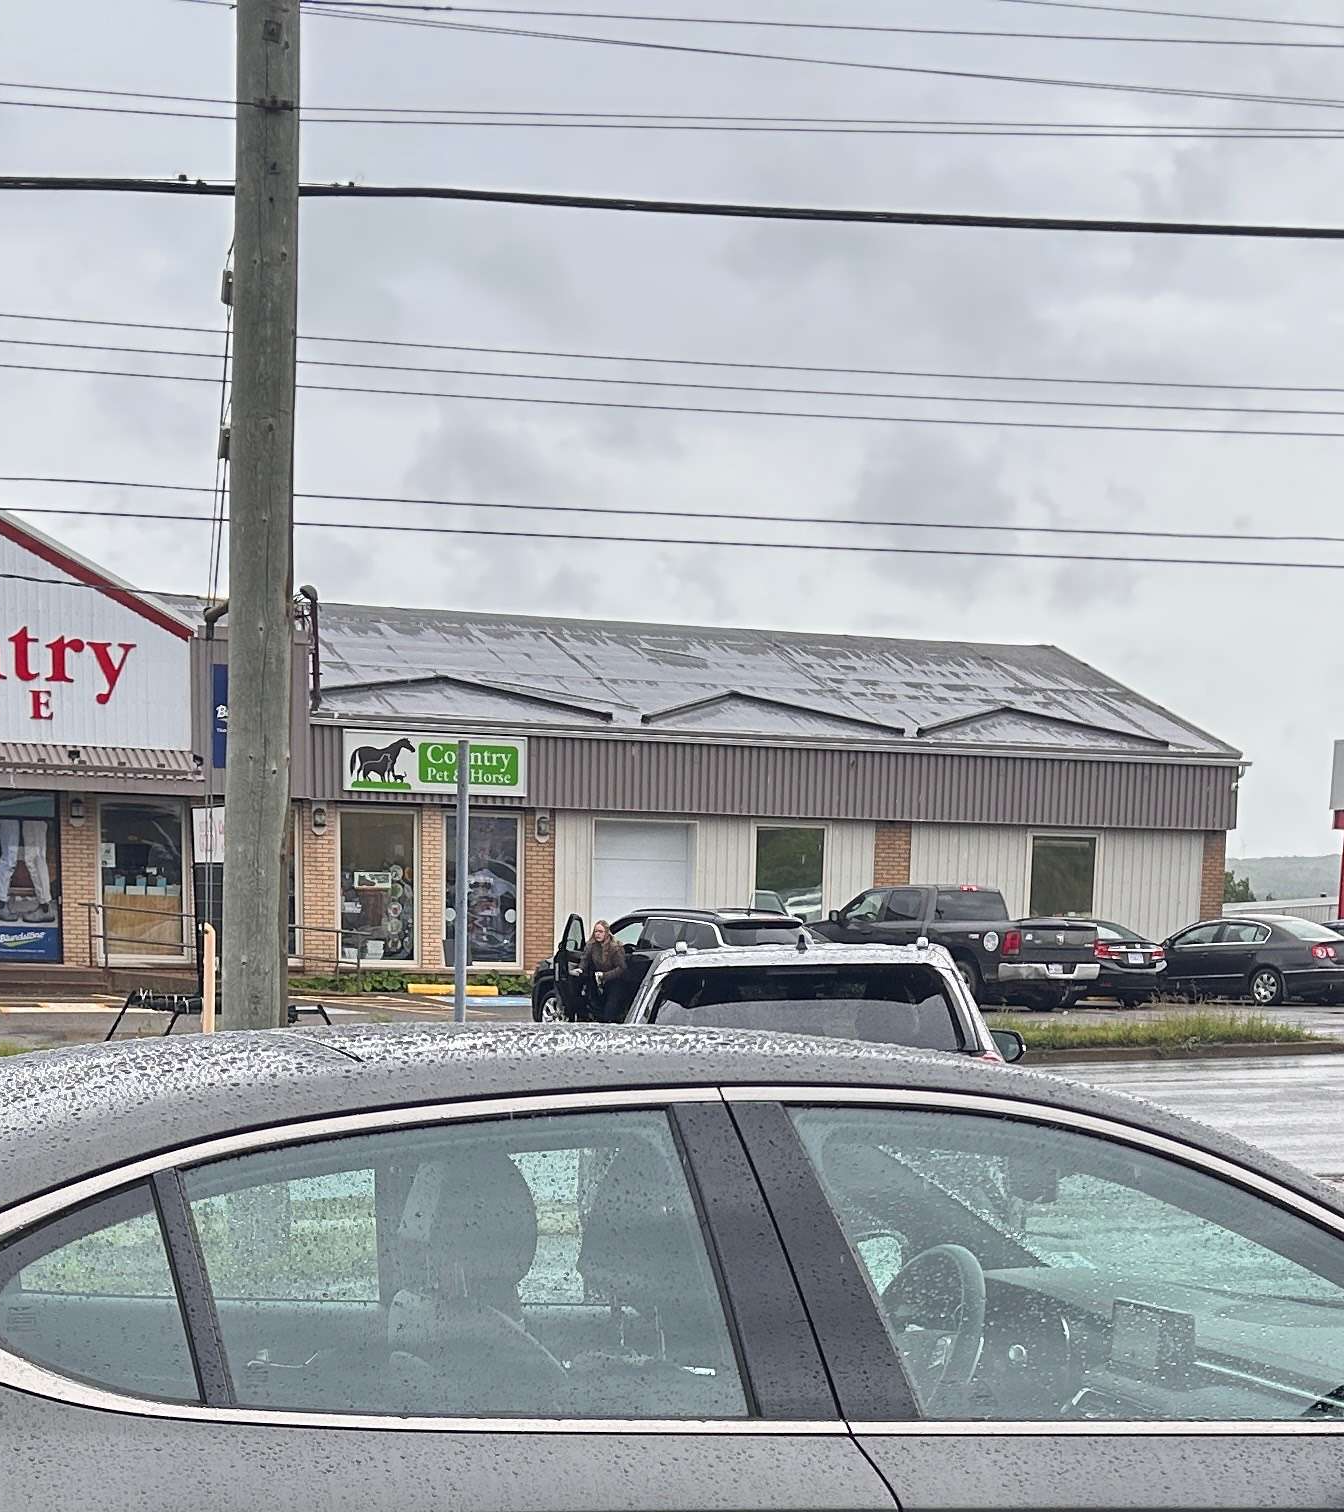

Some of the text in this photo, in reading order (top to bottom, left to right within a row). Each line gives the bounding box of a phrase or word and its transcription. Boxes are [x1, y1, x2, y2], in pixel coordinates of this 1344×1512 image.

[426, 744, 513, 773] Contry
[427, 767, 449, 782] Pet
[470, 769, 513, 784] Horse
